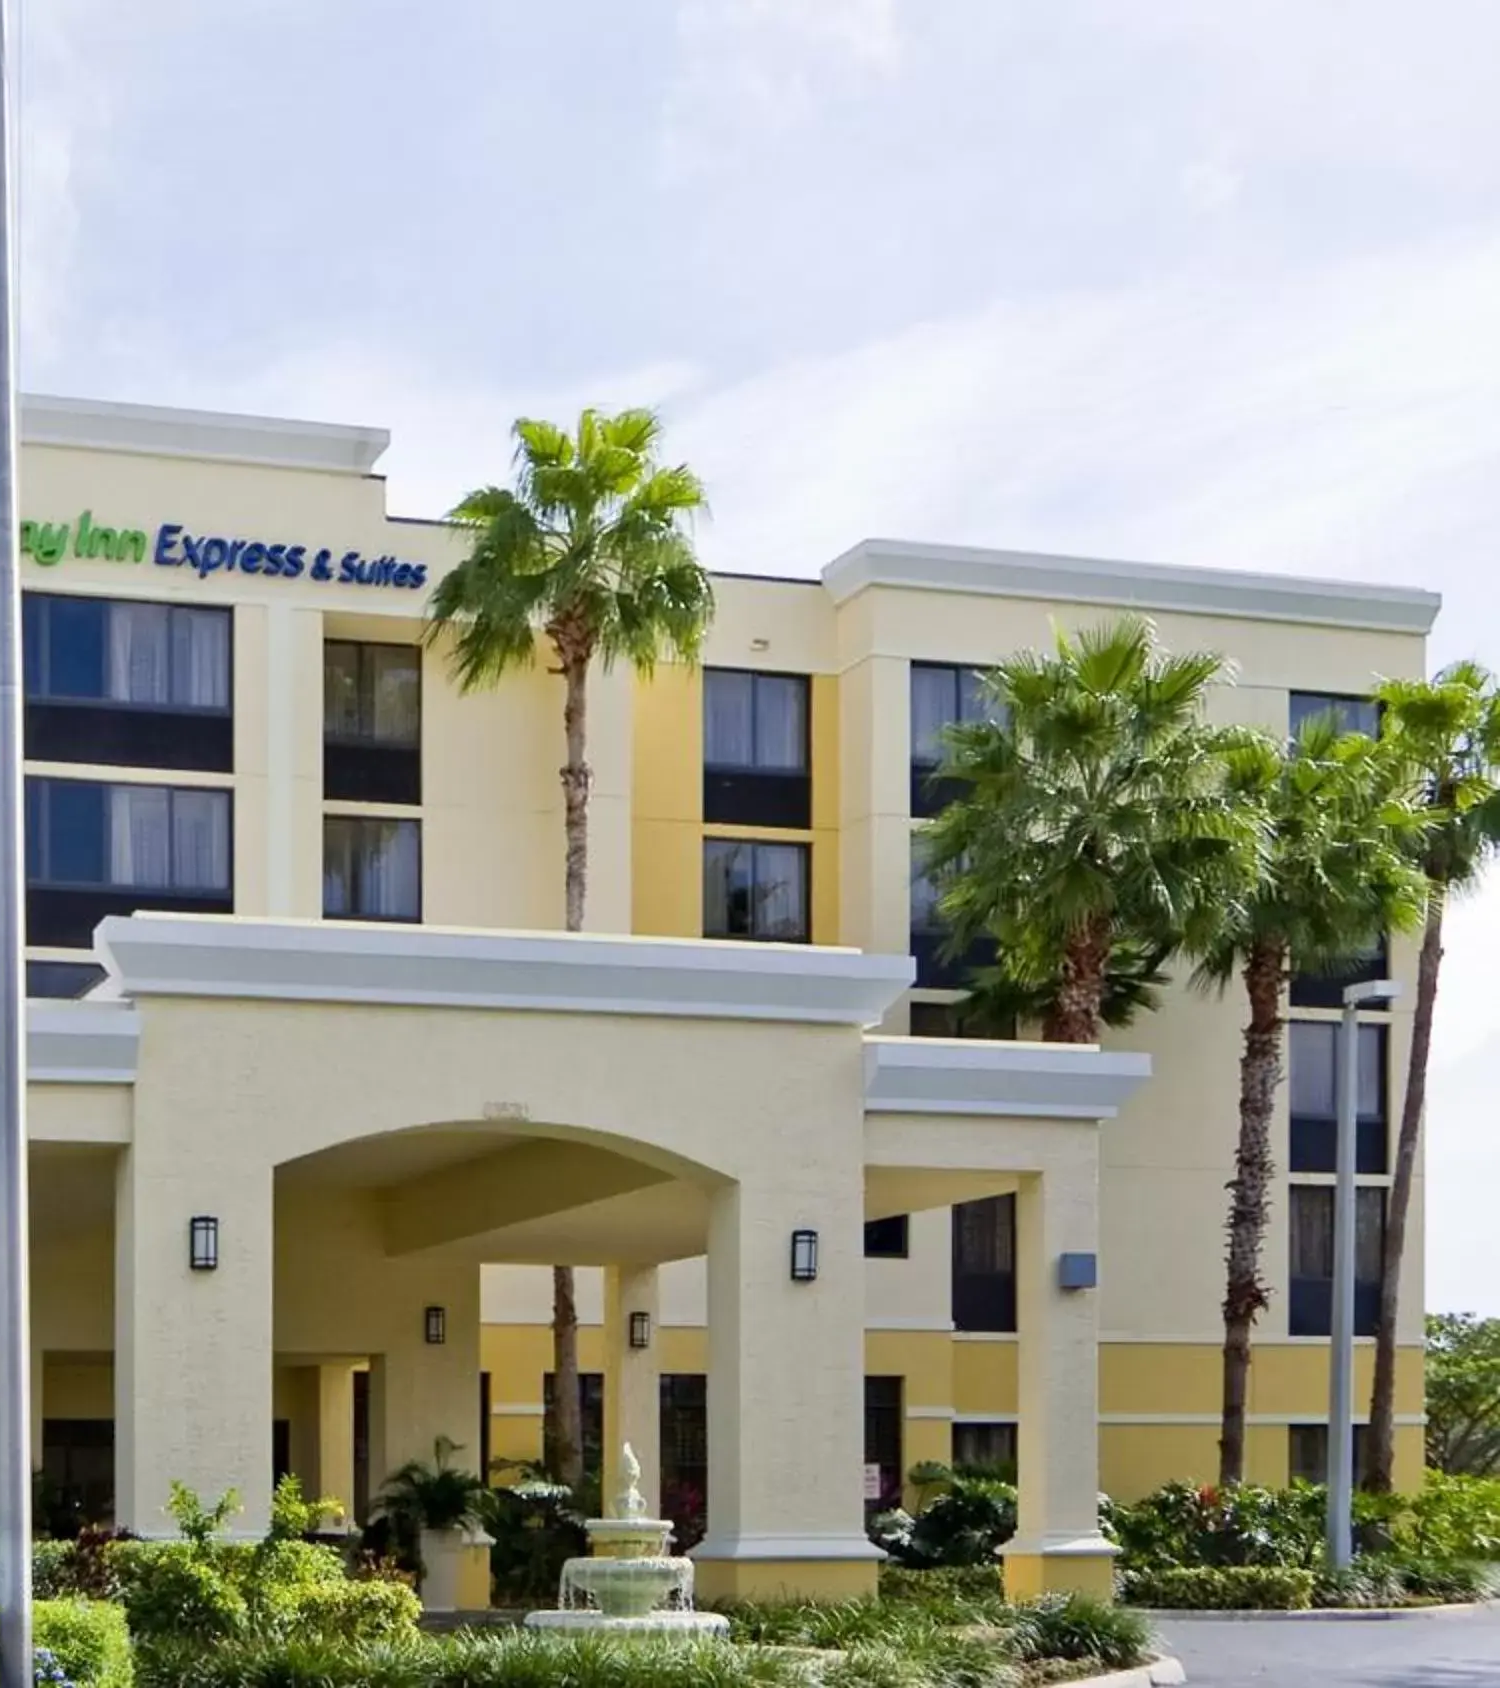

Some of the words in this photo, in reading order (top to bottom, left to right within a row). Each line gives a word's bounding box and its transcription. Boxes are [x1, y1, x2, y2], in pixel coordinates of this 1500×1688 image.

[73, 509, 147, 564] Inn
[153, 523, 306, 580] Express
[310, 549, 334, 581] &
[336, 551, 428, 589] Suites
